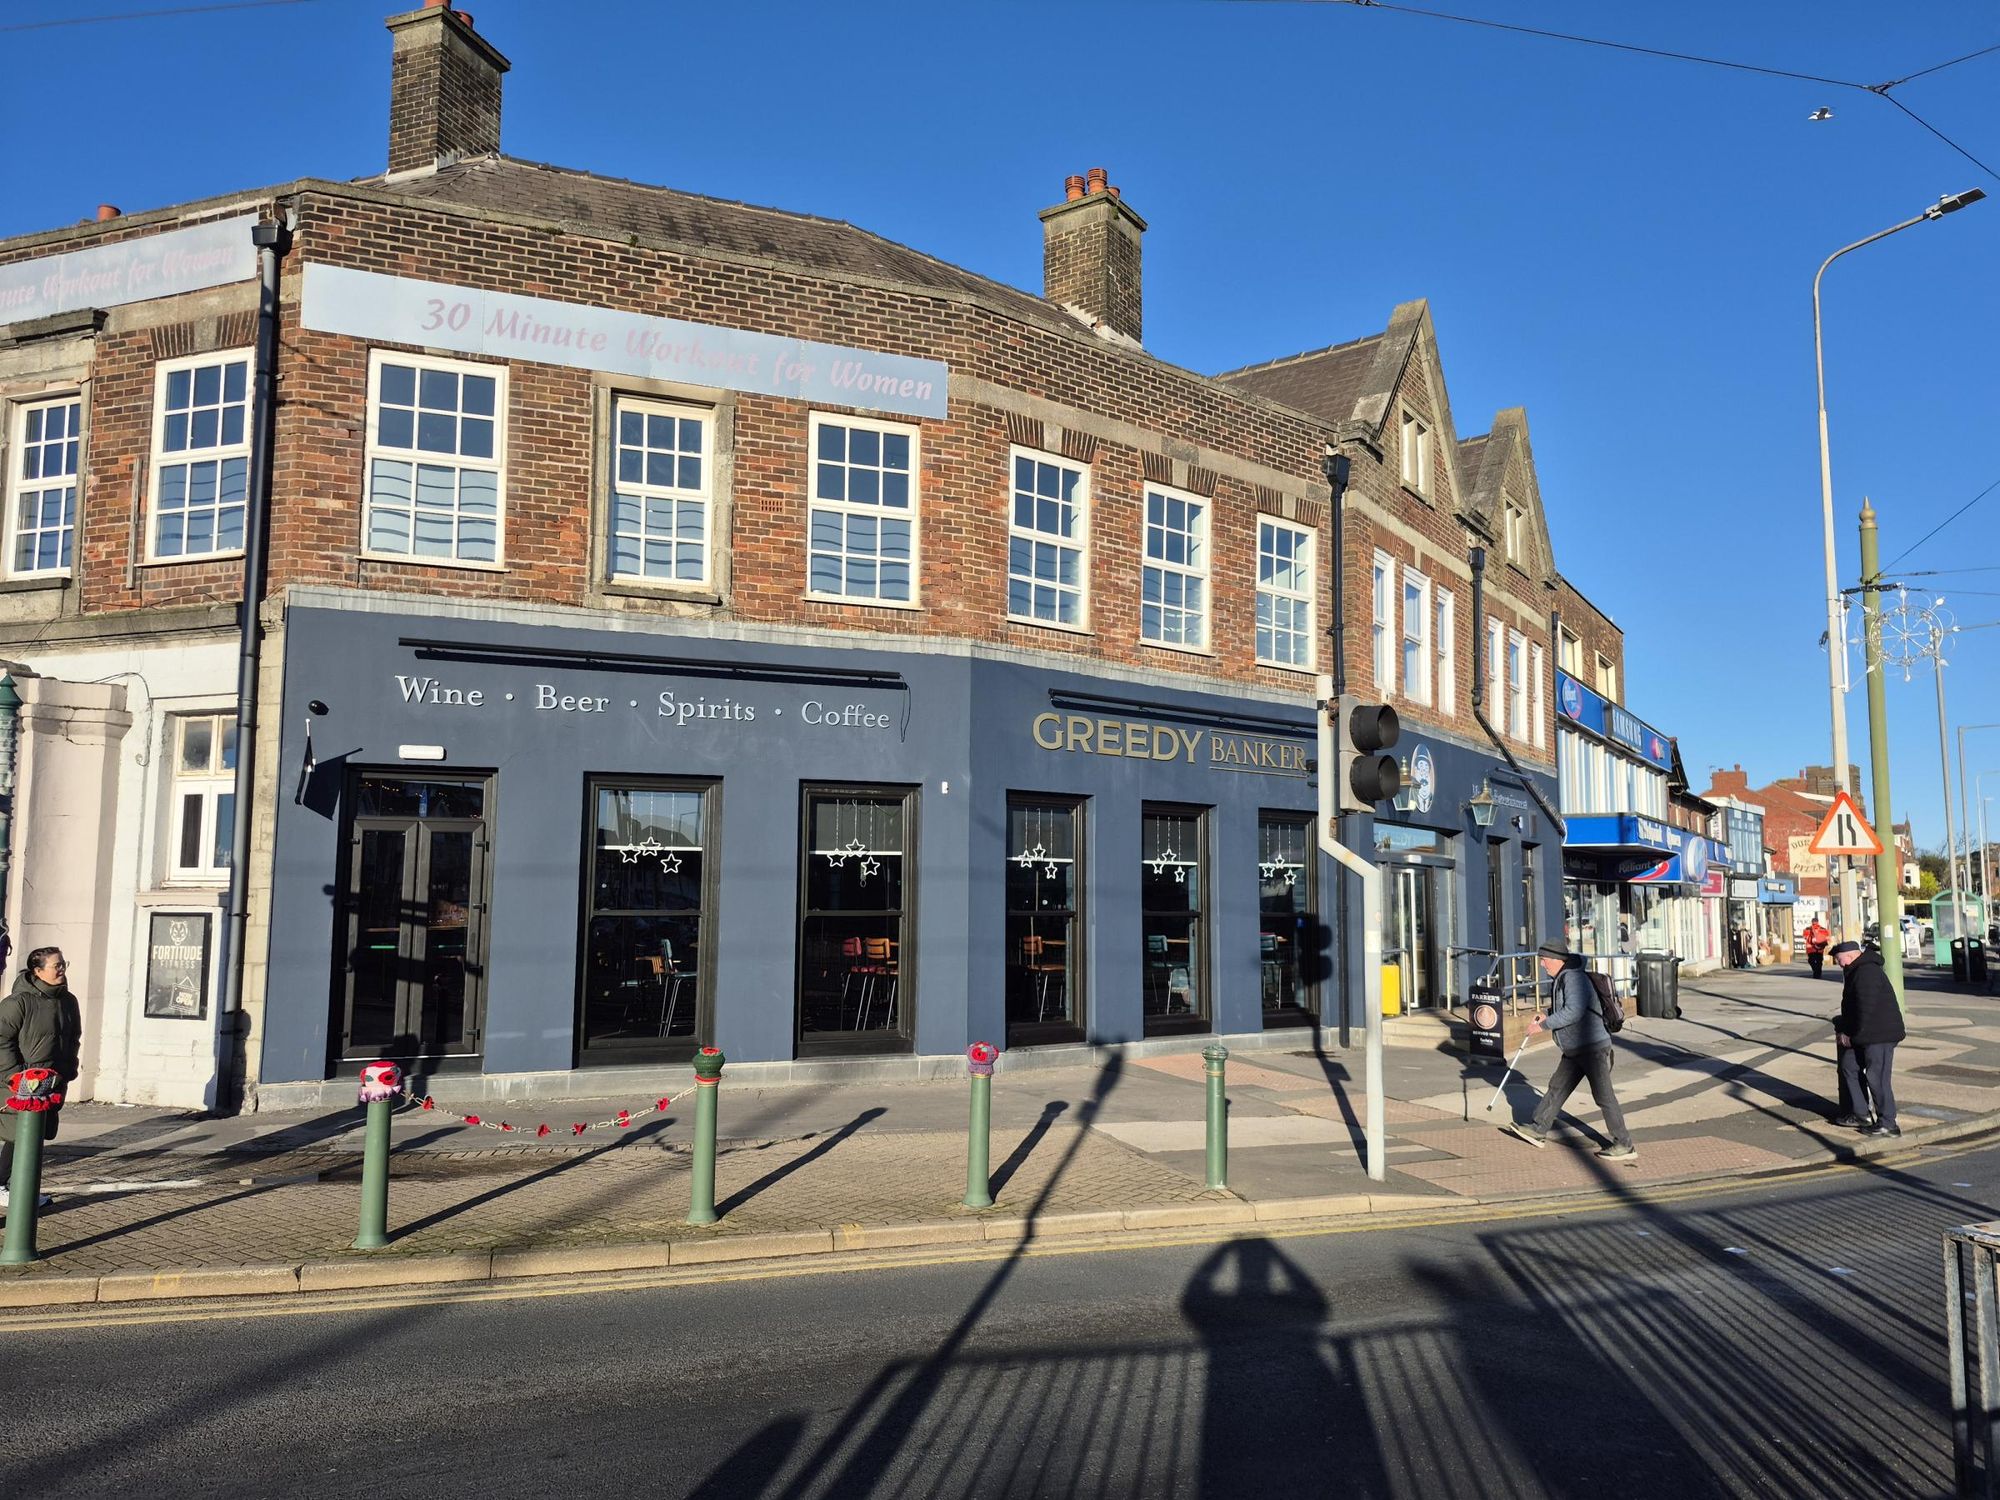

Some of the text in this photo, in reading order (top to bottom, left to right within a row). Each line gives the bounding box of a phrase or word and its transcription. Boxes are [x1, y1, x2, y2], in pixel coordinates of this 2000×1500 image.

[128, 257, 156, 293] for
[421, 298, 933, 401] 30 Minute Workout for Women
[394, 674, 891, 729] Wine Beer Spirits Coffee
[1032, 711, 1308, 771] GREEDY BANKER
[153, 945, 203, 960] FORTITUDE
[160, 961, 195, 969] FITNESS
